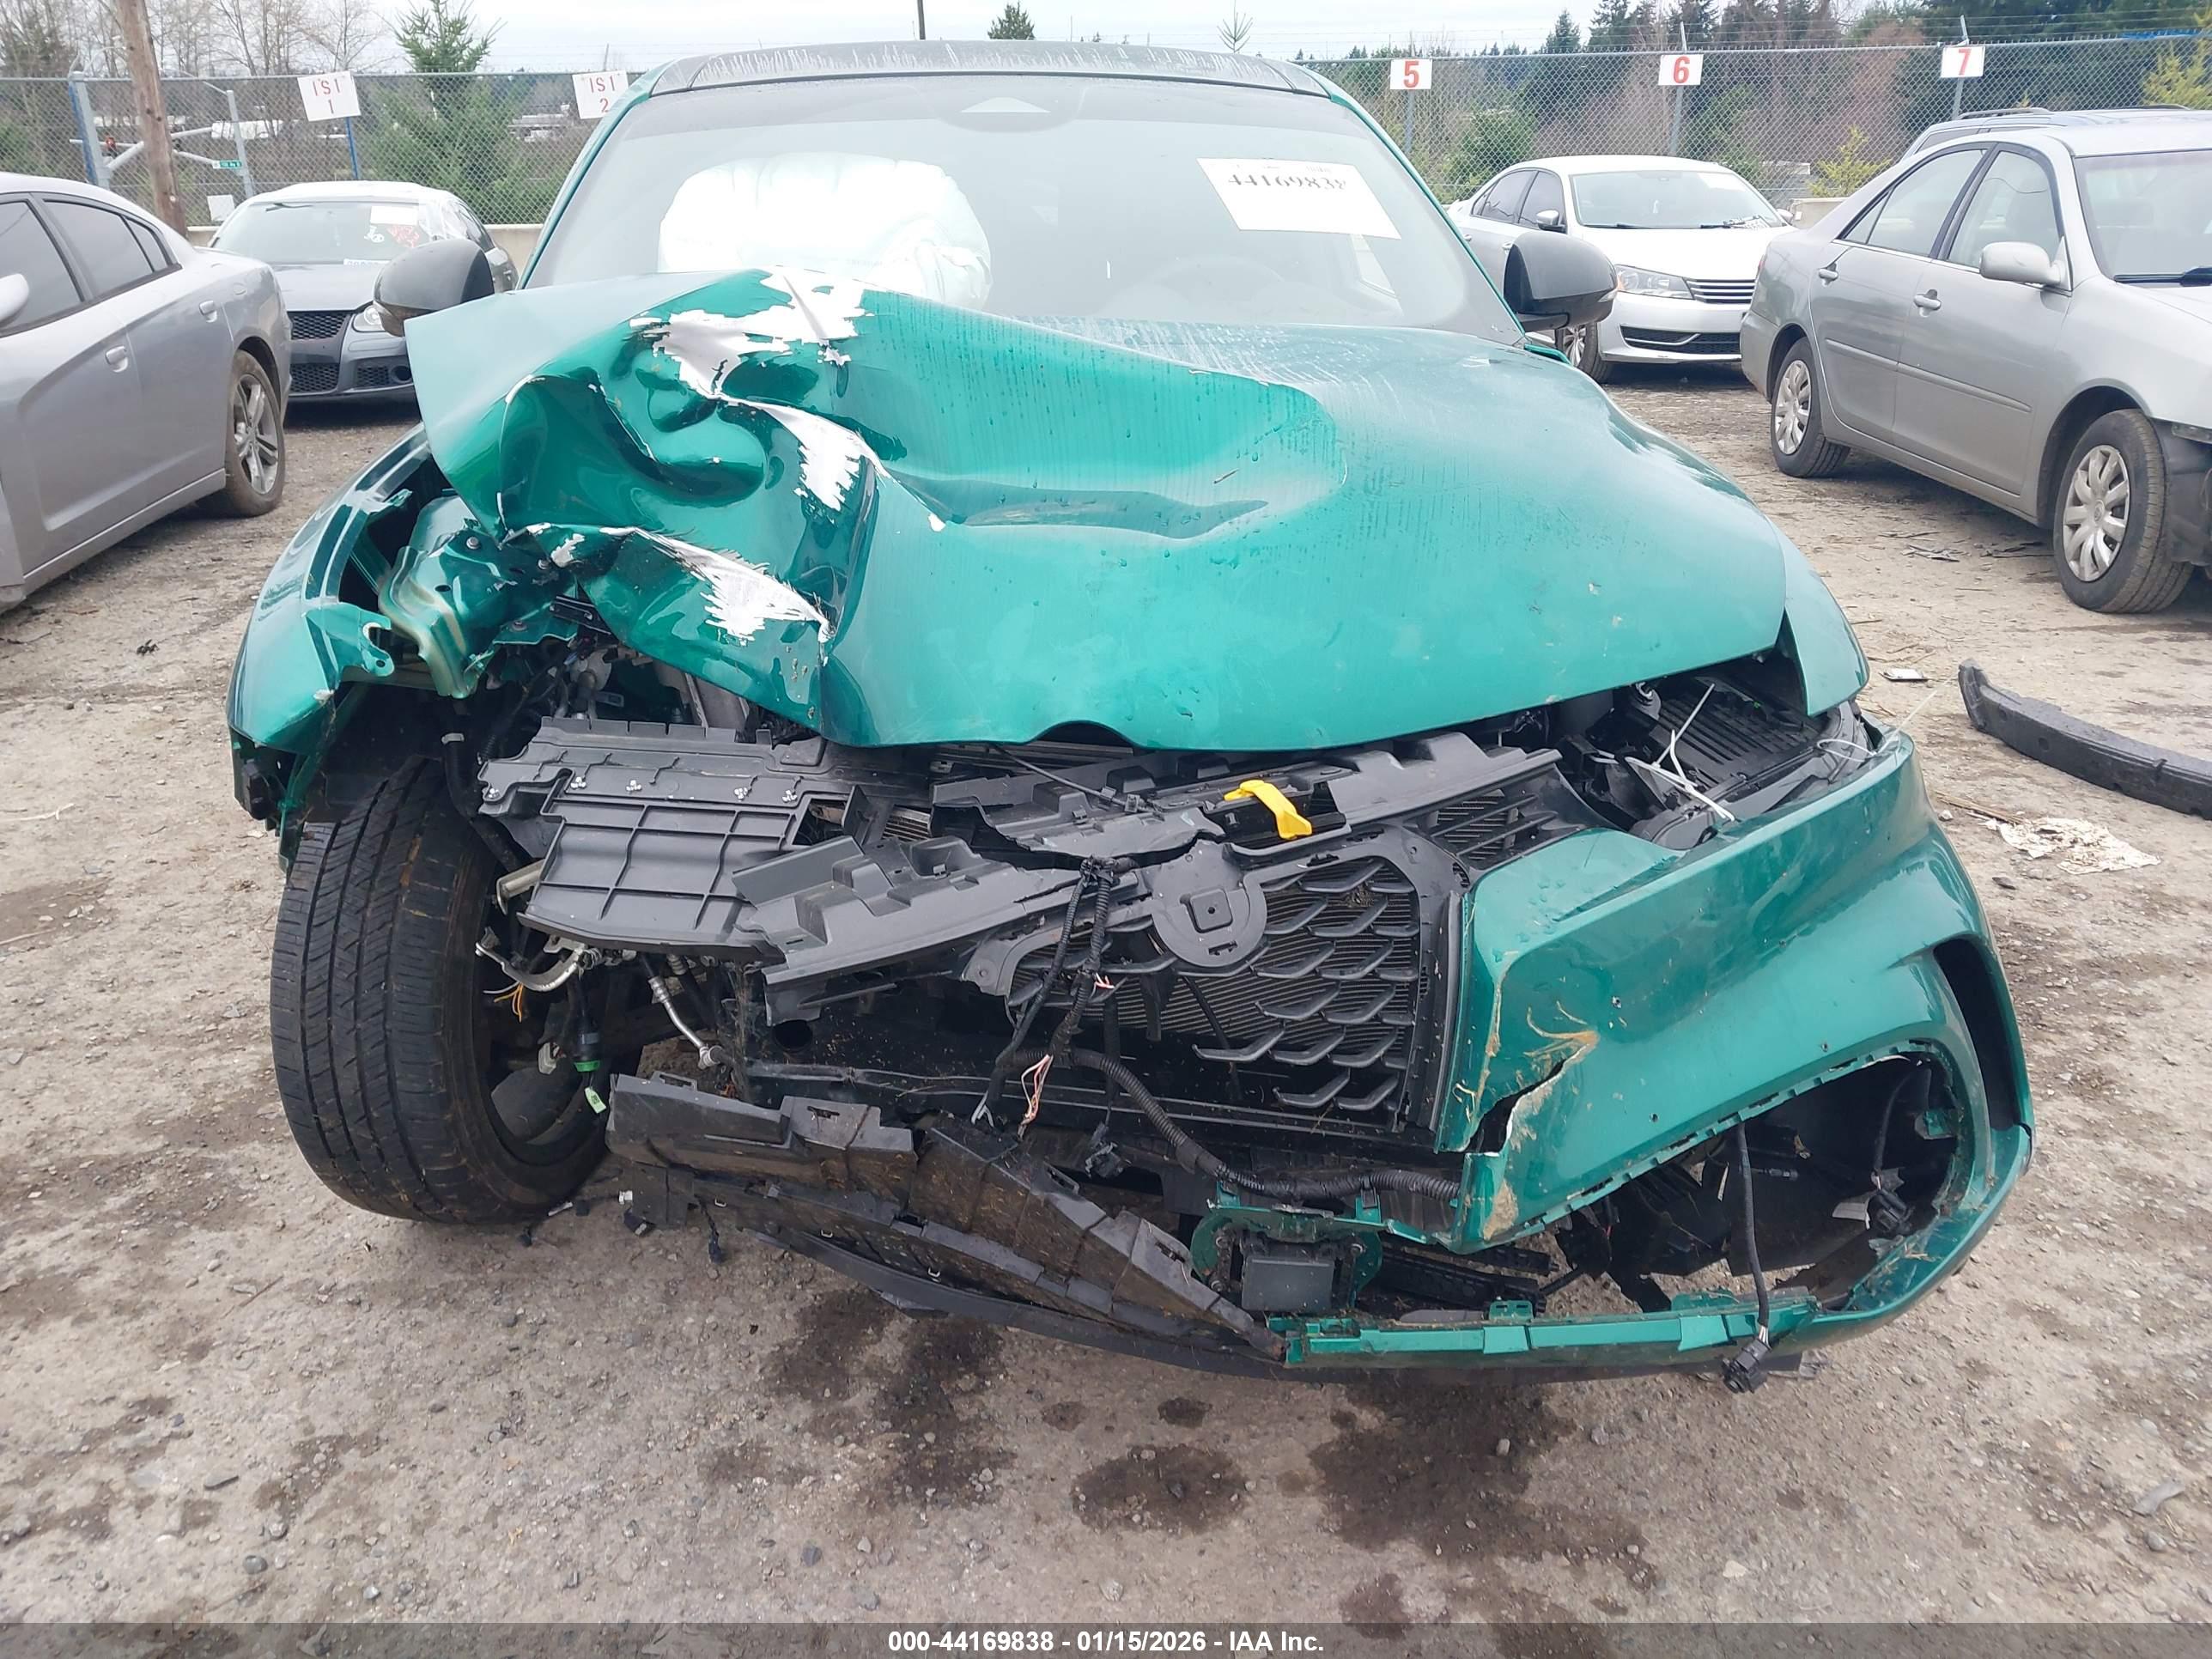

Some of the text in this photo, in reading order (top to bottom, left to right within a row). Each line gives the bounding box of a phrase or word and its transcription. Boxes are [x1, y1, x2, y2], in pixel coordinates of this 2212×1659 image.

[1403, 60, 1419, 88] 5
[1674, 56, 1690, 83] 6
[1959, 48, 1972, 76] 7
[599, 98, 609, 113] 2
